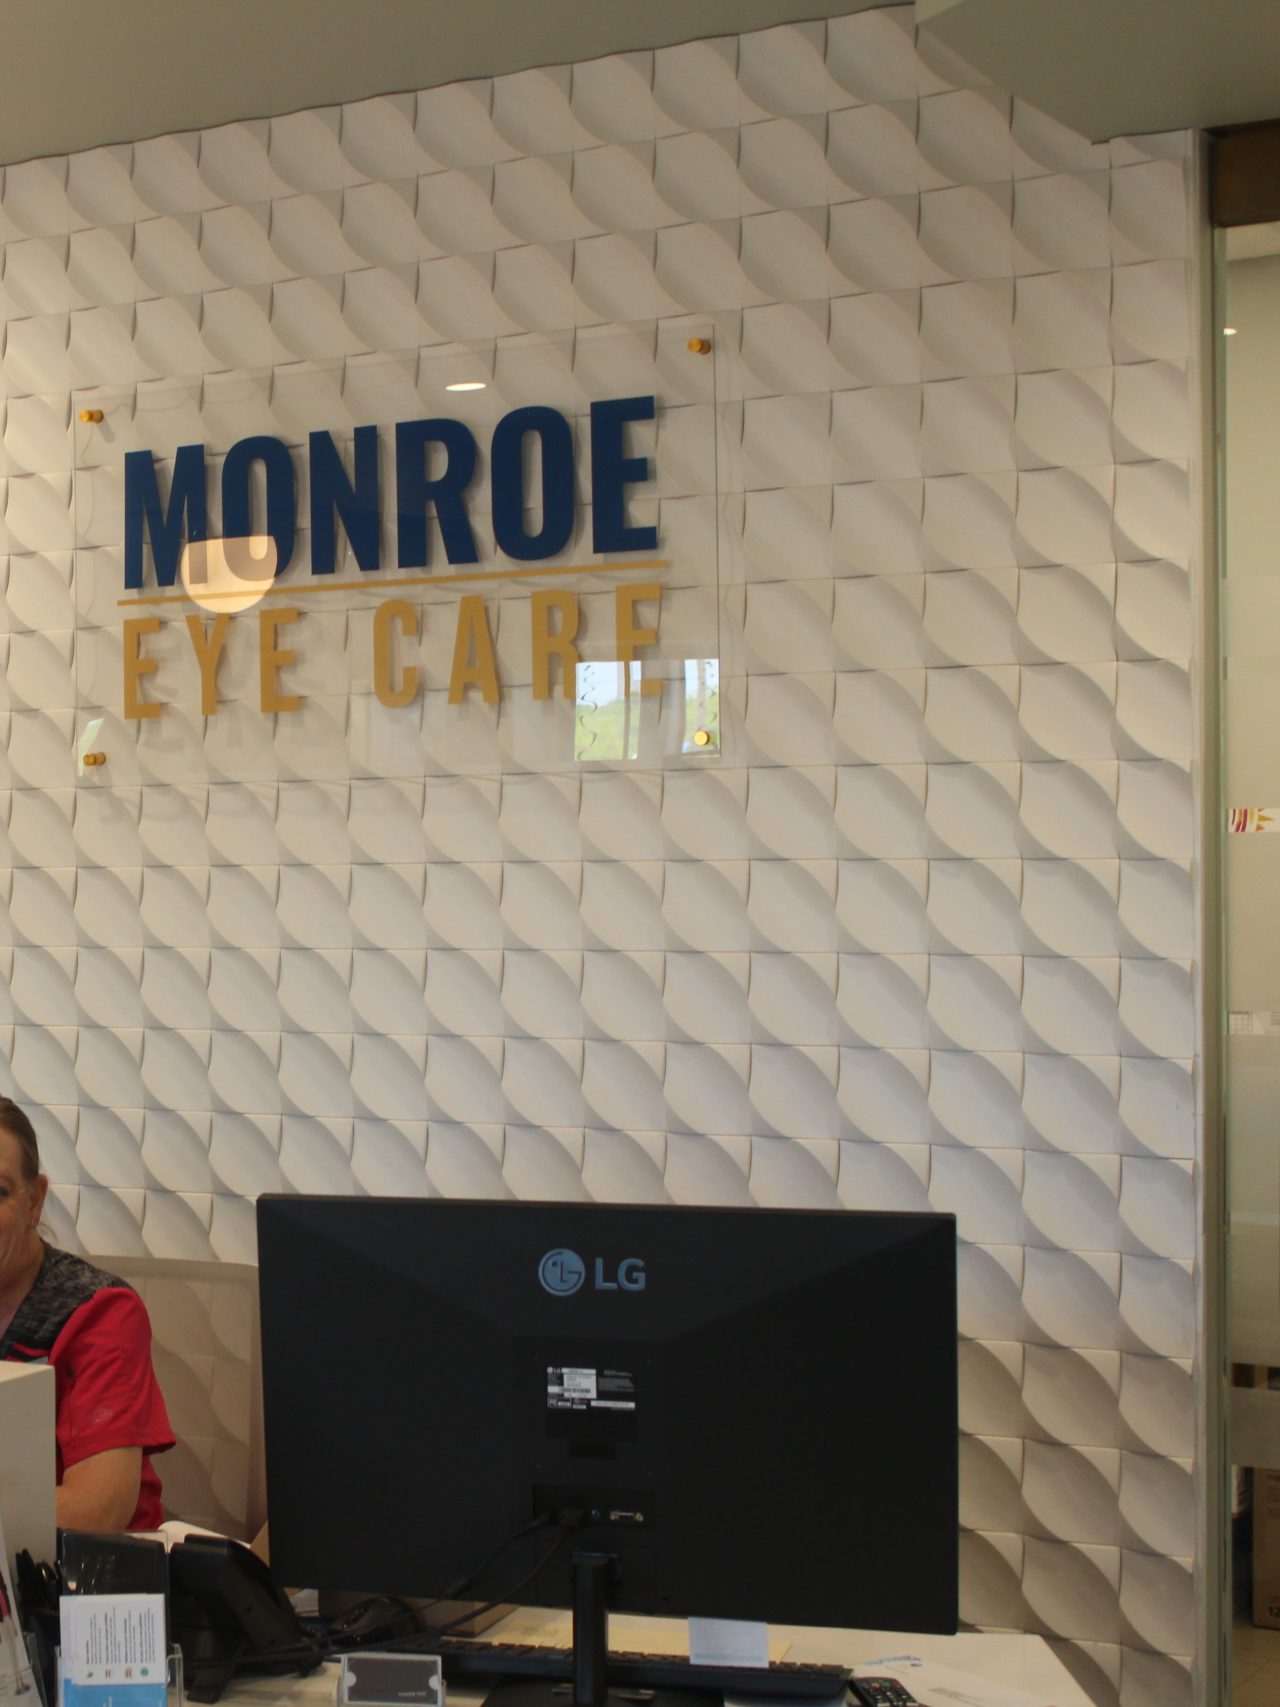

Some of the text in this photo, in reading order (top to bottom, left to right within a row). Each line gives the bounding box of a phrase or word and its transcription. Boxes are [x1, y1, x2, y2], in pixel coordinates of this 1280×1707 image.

[124, 395, 658, 589] MONROE
[122, 582, 663, 720] EYE CARE
[594, 1256, 647, 1292] LG
